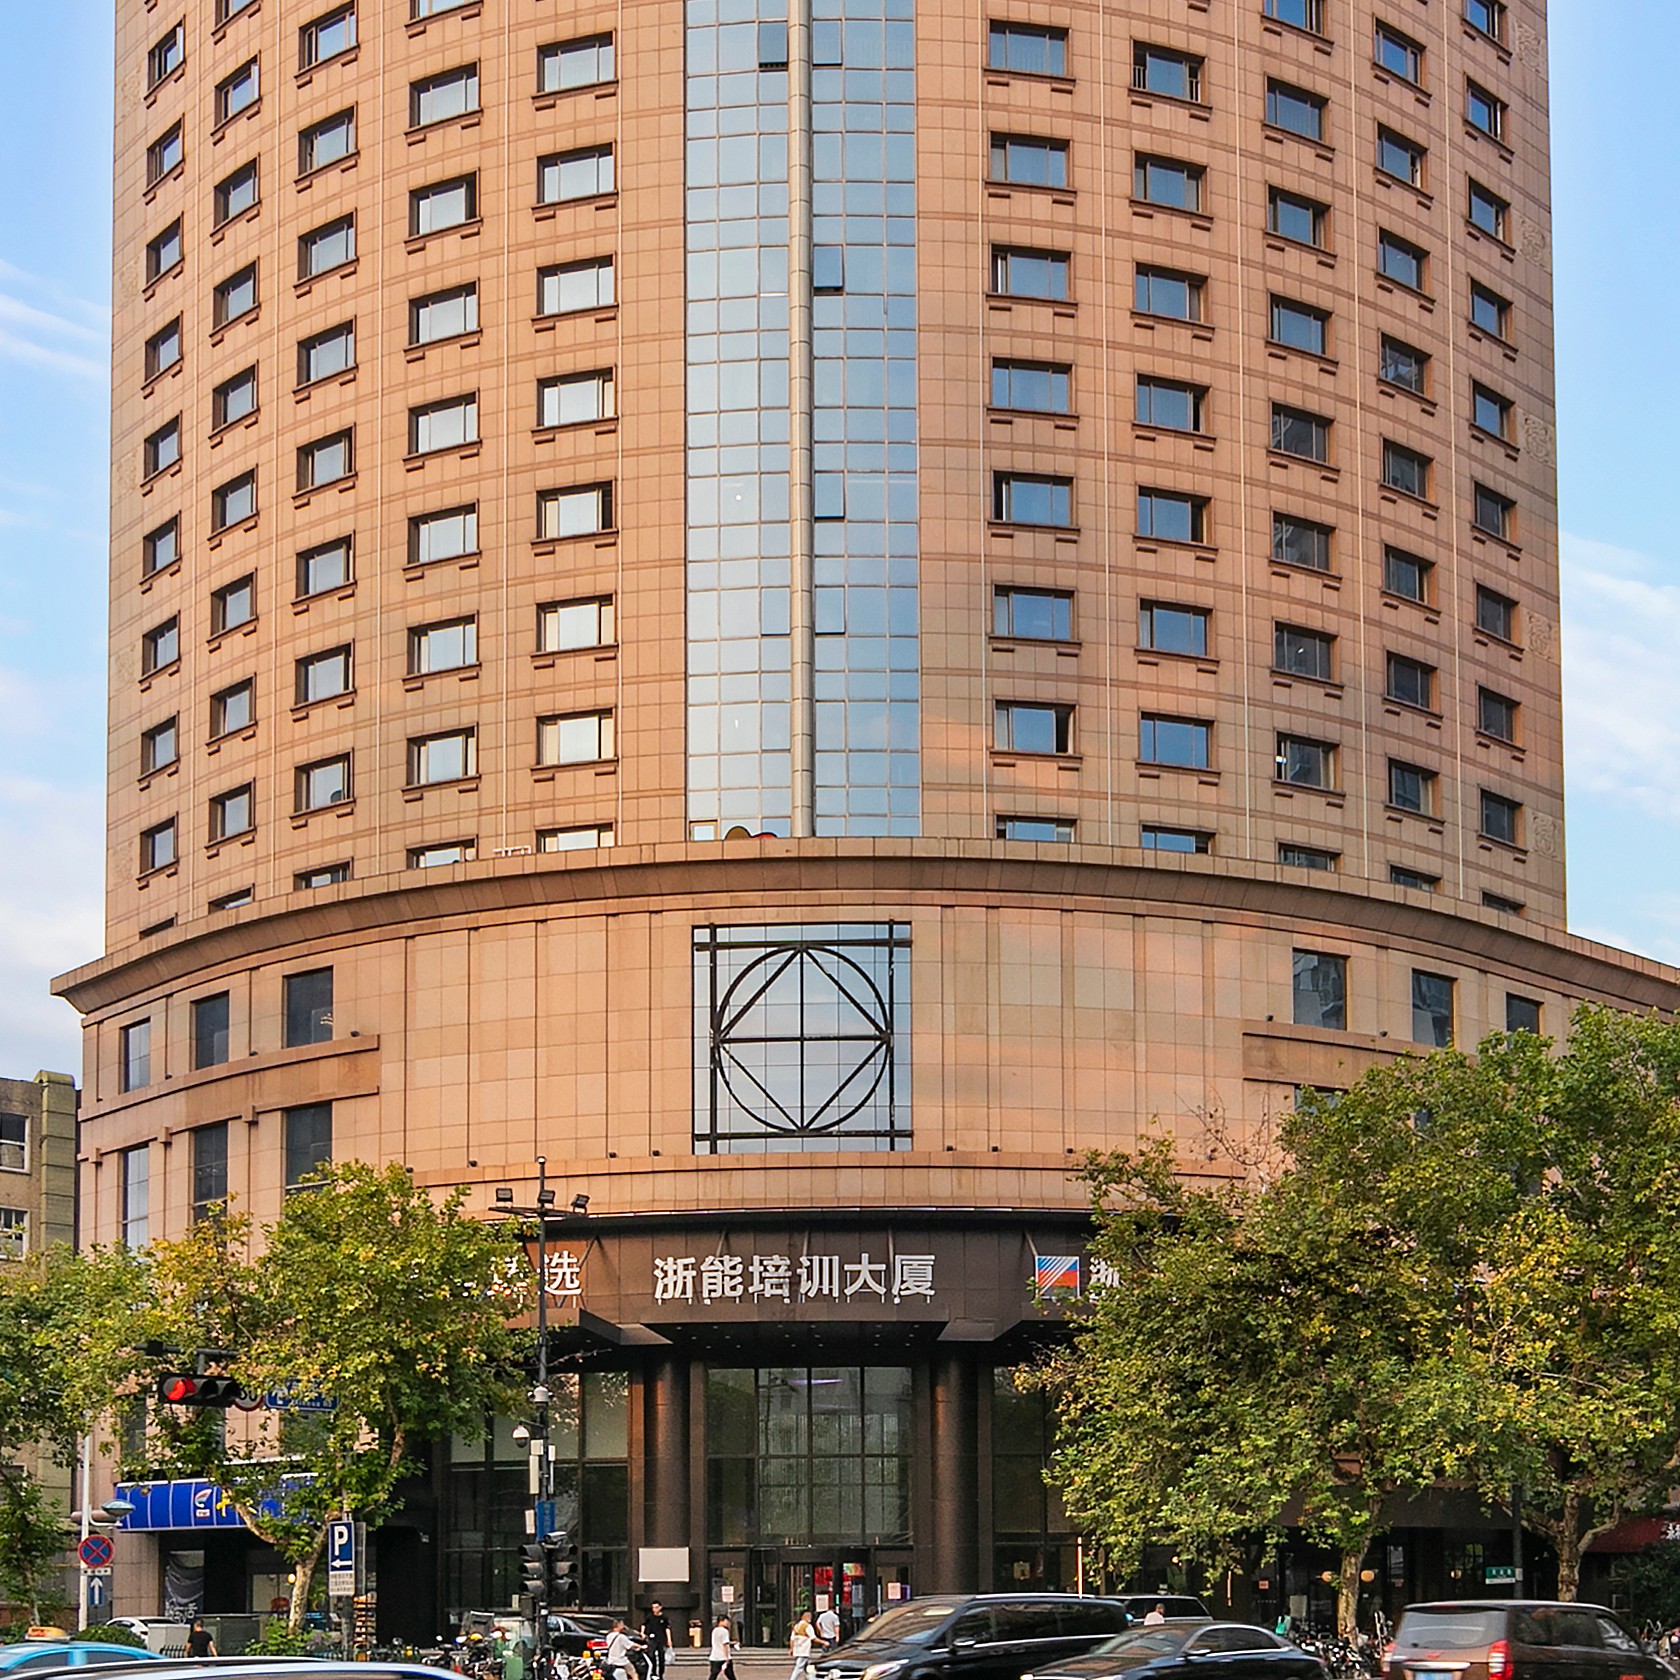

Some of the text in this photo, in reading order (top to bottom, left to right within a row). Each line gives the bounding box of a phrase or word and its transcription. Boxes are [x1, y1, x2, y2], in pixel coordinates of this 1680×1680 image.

[653, 1253, 936, 1299] 浙能培训大厦
[334, 1525, 348, 1556] P
